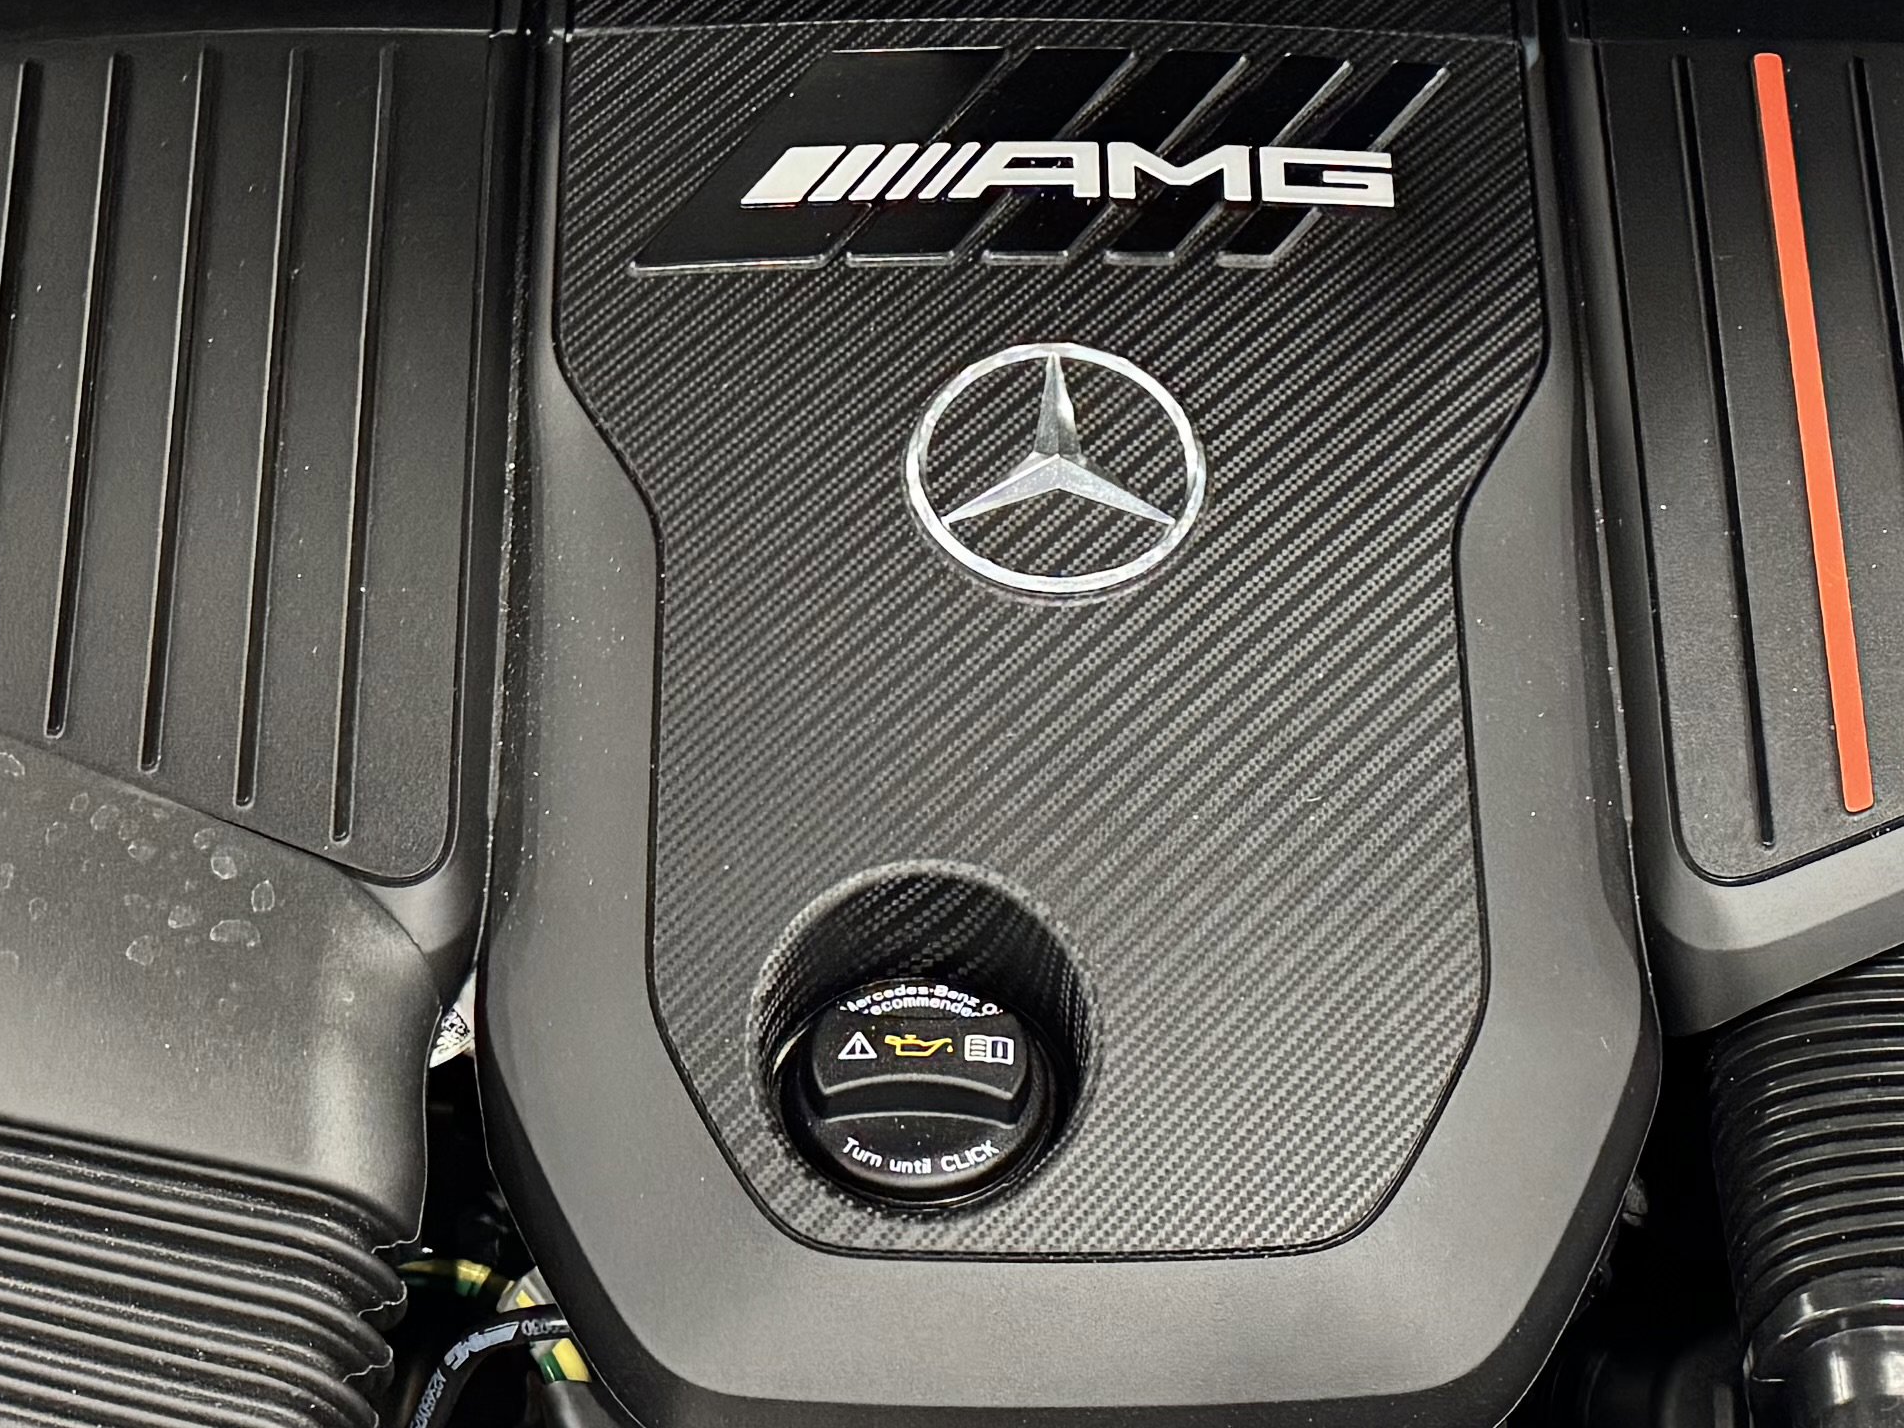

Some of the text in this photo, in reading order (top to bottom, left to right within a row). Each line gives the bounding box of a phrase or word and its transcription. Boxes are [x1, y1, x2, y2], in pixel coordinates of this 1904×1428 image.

[960, 139, 1396, 208] AMG
[841, 1136, 1001, 1174] Turn until CLICK
